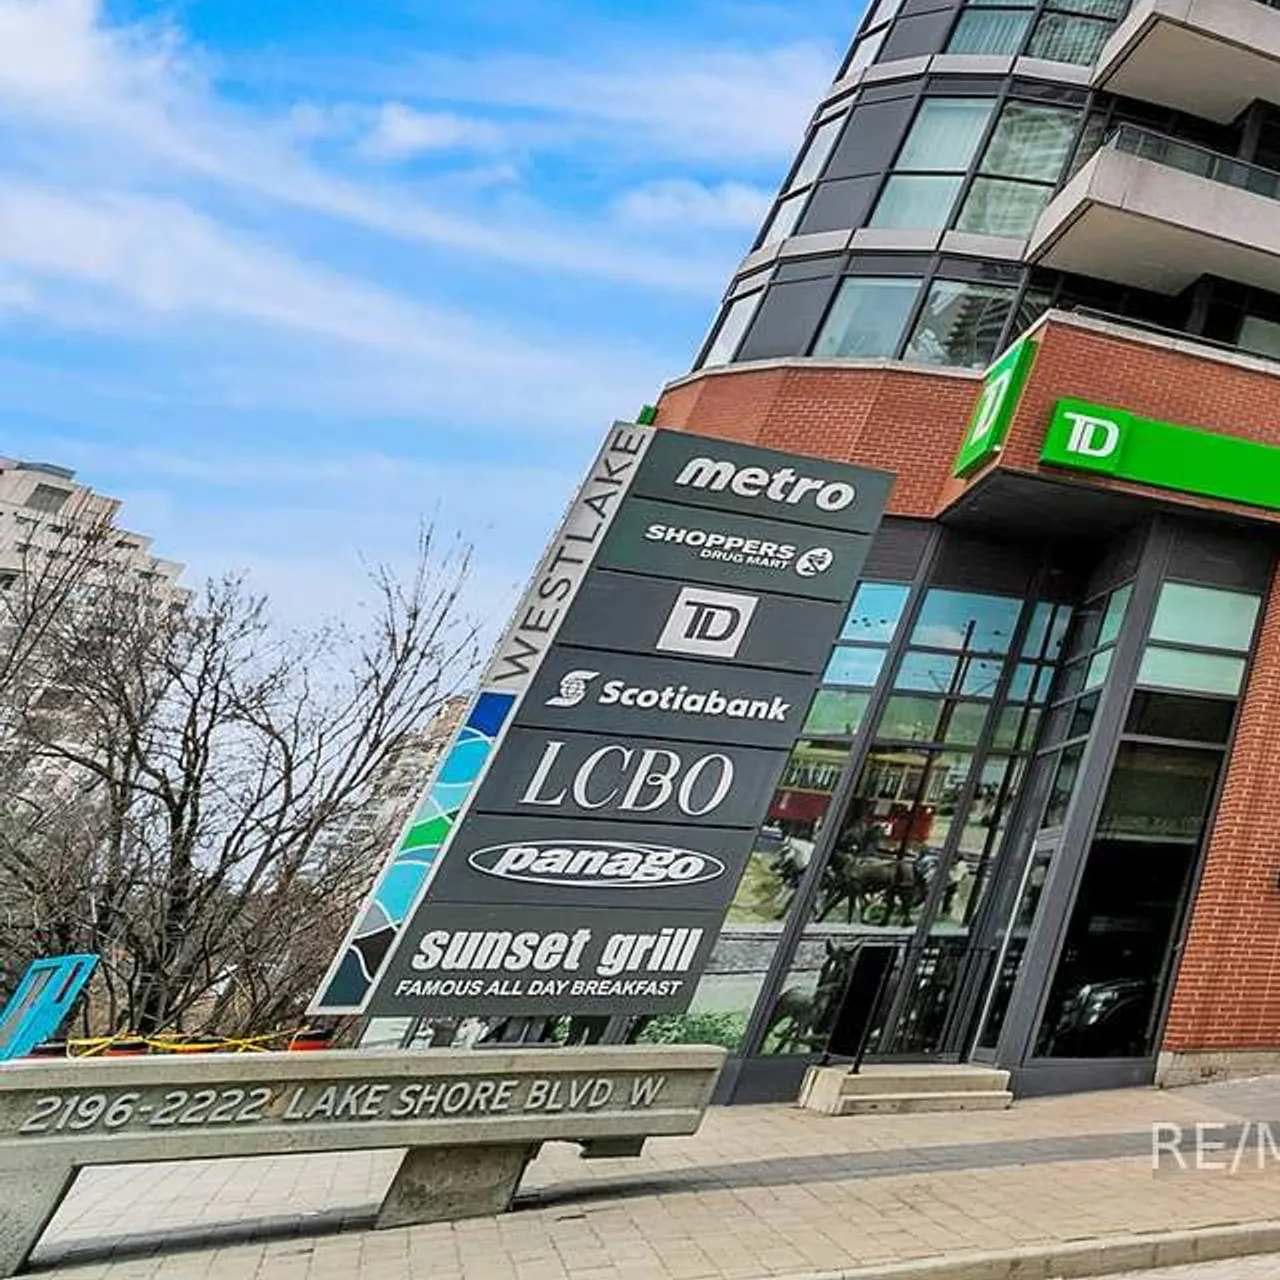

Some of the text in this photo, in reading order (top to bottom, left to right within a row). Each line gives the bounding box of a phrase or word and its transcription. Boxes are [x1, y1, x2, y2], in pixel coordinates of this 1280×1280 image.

[1063, 411, 1120, 457] TD
[675, 457, 856, 512] metro
[493, 429, 646, 681] WESTLAKE
[645, 524, 796, 560] SHOPPERS
[700, 548, 790, 570] DRUG MART
[683, 600, 741, 642] TD
[599, 680, 791, 722] Scotiabank
[518, 740, 734, 816] LCBO
[491, 846, 705, 883] panago
[411, 928, 703, 976] sunset grill
[394, 979, 683, 997] FAMOUS ALL DAY BREAKFAST
[20, 1075, 666, 1132] 2196-2222 LAKE SHORE BLVD W
